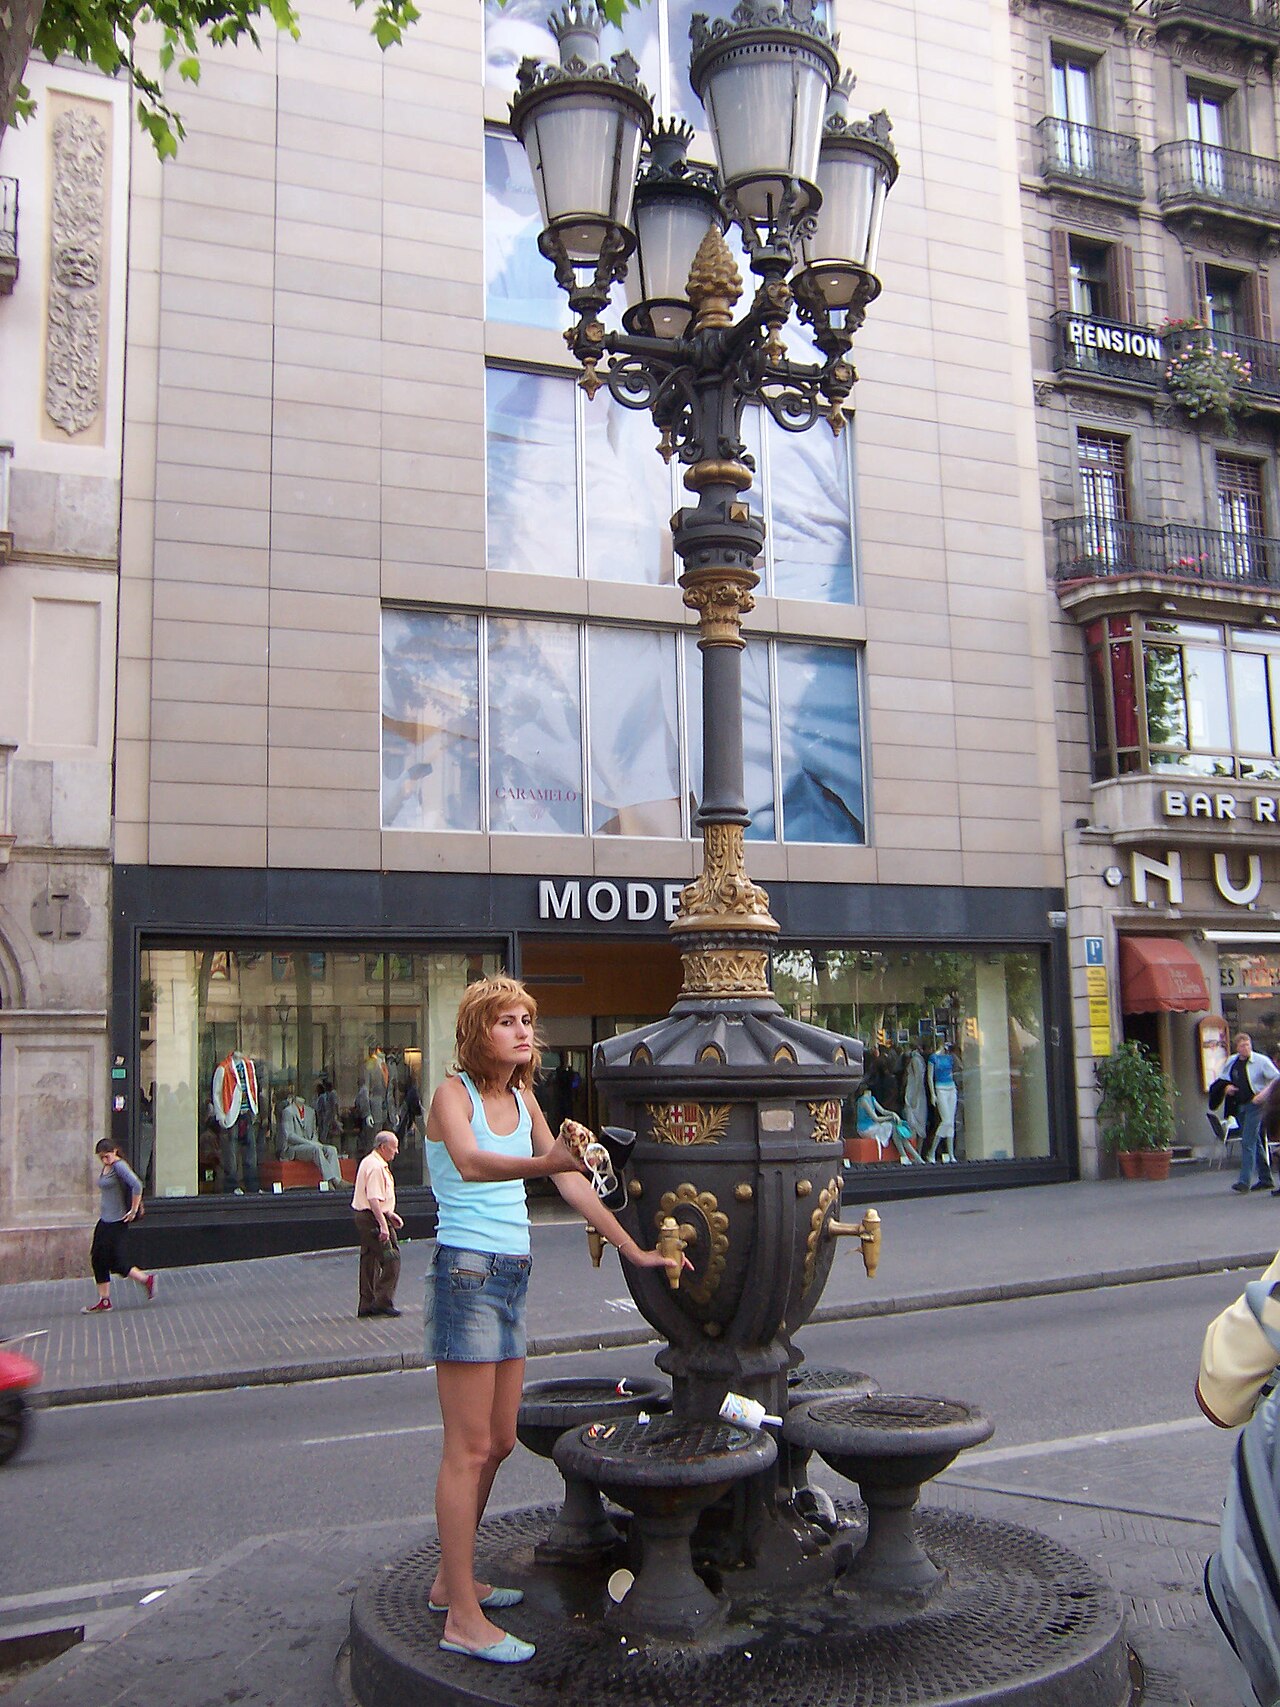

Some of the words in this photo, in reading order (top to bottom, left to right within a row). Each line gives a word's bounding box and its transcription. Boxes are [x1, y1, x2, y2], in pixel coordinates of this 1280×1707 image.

[1069, 320, 1161, 361] PENSION
[495, 787, 577, 801] CARAMELO
[1162, 790, 1237, 819] BAR
[1252, 796, 1280, 823] R
